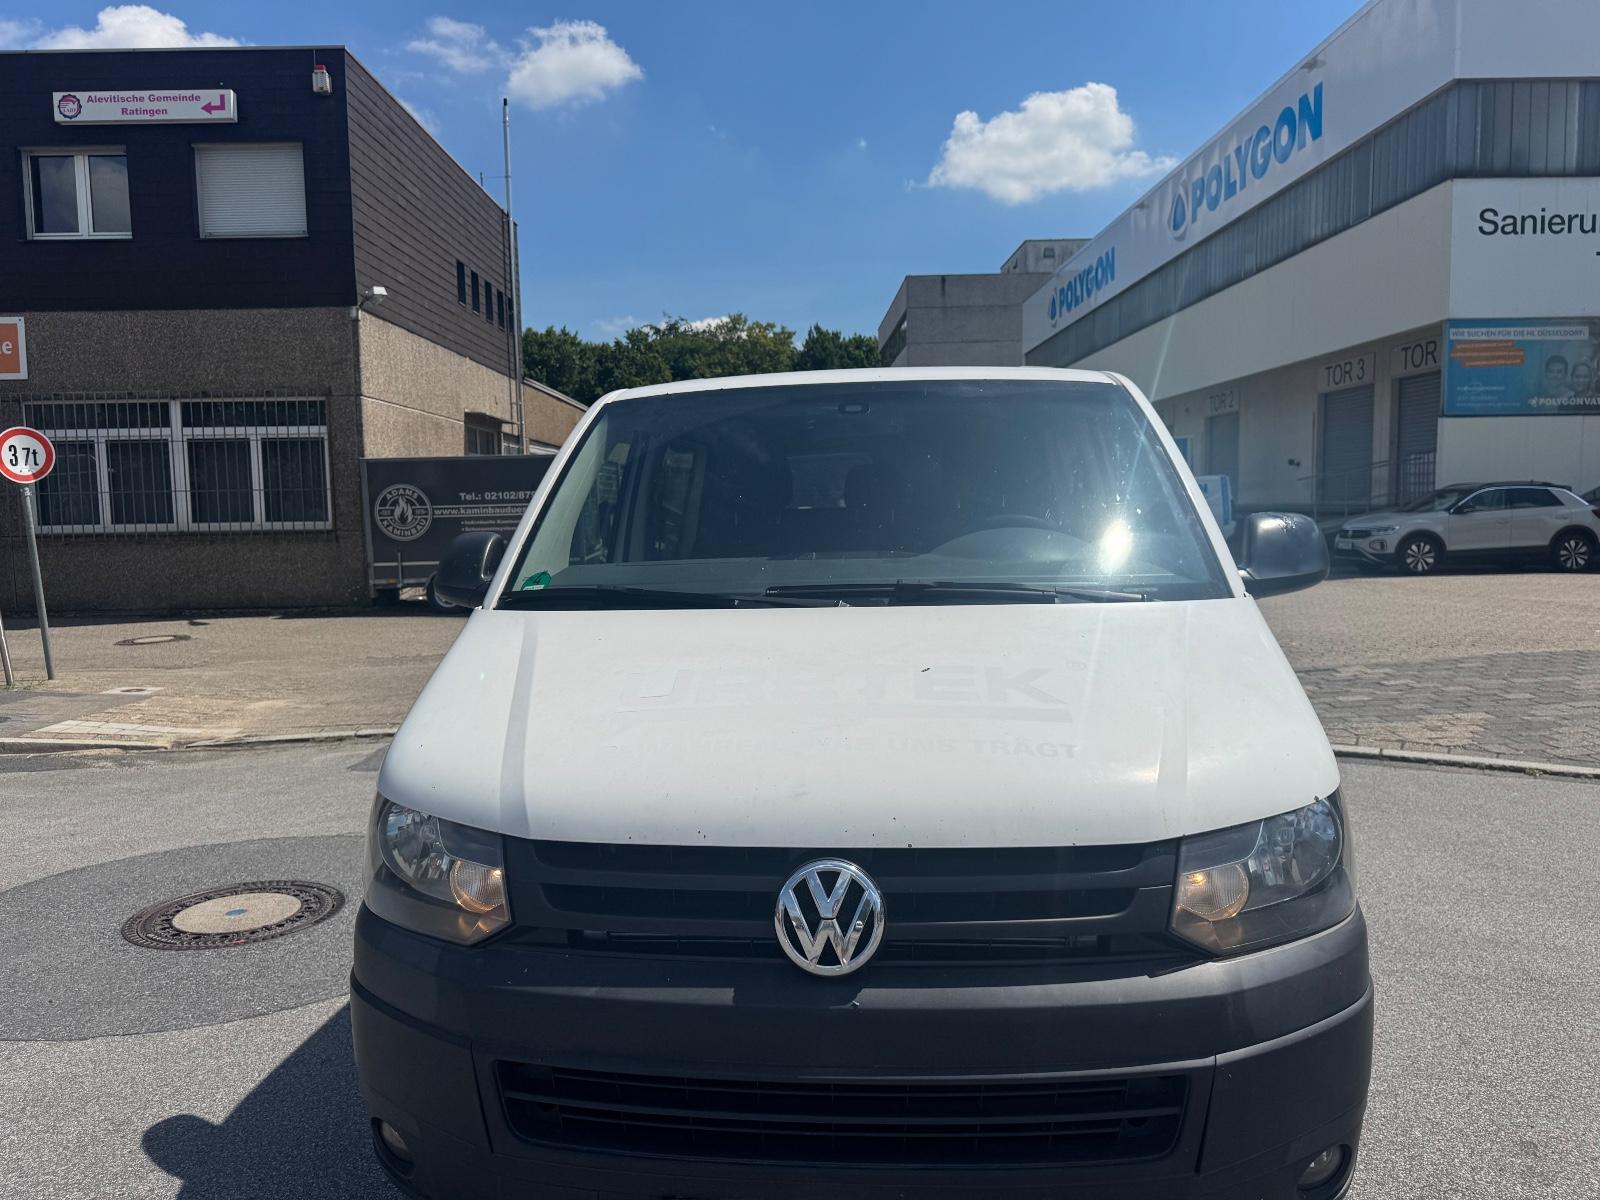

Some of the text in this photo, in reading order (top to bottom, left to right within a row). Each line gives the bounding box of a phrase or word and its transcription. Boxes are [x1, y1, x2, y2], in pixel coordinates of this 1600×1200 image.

[86, 93, 201, 104] Alevitische Gemeinde
[121, 107, 168, 117] Ratingen
[1190, 80, 1324, 225] POLYGON
[1478, 207, 1600, 236] Sanieru
[1058, 246, 1116, 318] POLYGON
[1400, 340, 1437, 370] TOR
[1325, 358, 1366, 387] TOR 3
[1209, 390, 1235, 412] TOR 2
[1538, 396, 1600, 407] POLYGONVA
[385, 488, 419, 500] ADAMS
[458, 492, 482, 500] Tel.:
[382, 518, 427, 537] KAMINBAU
[973, 737, 1081, 760] TRÄGT
